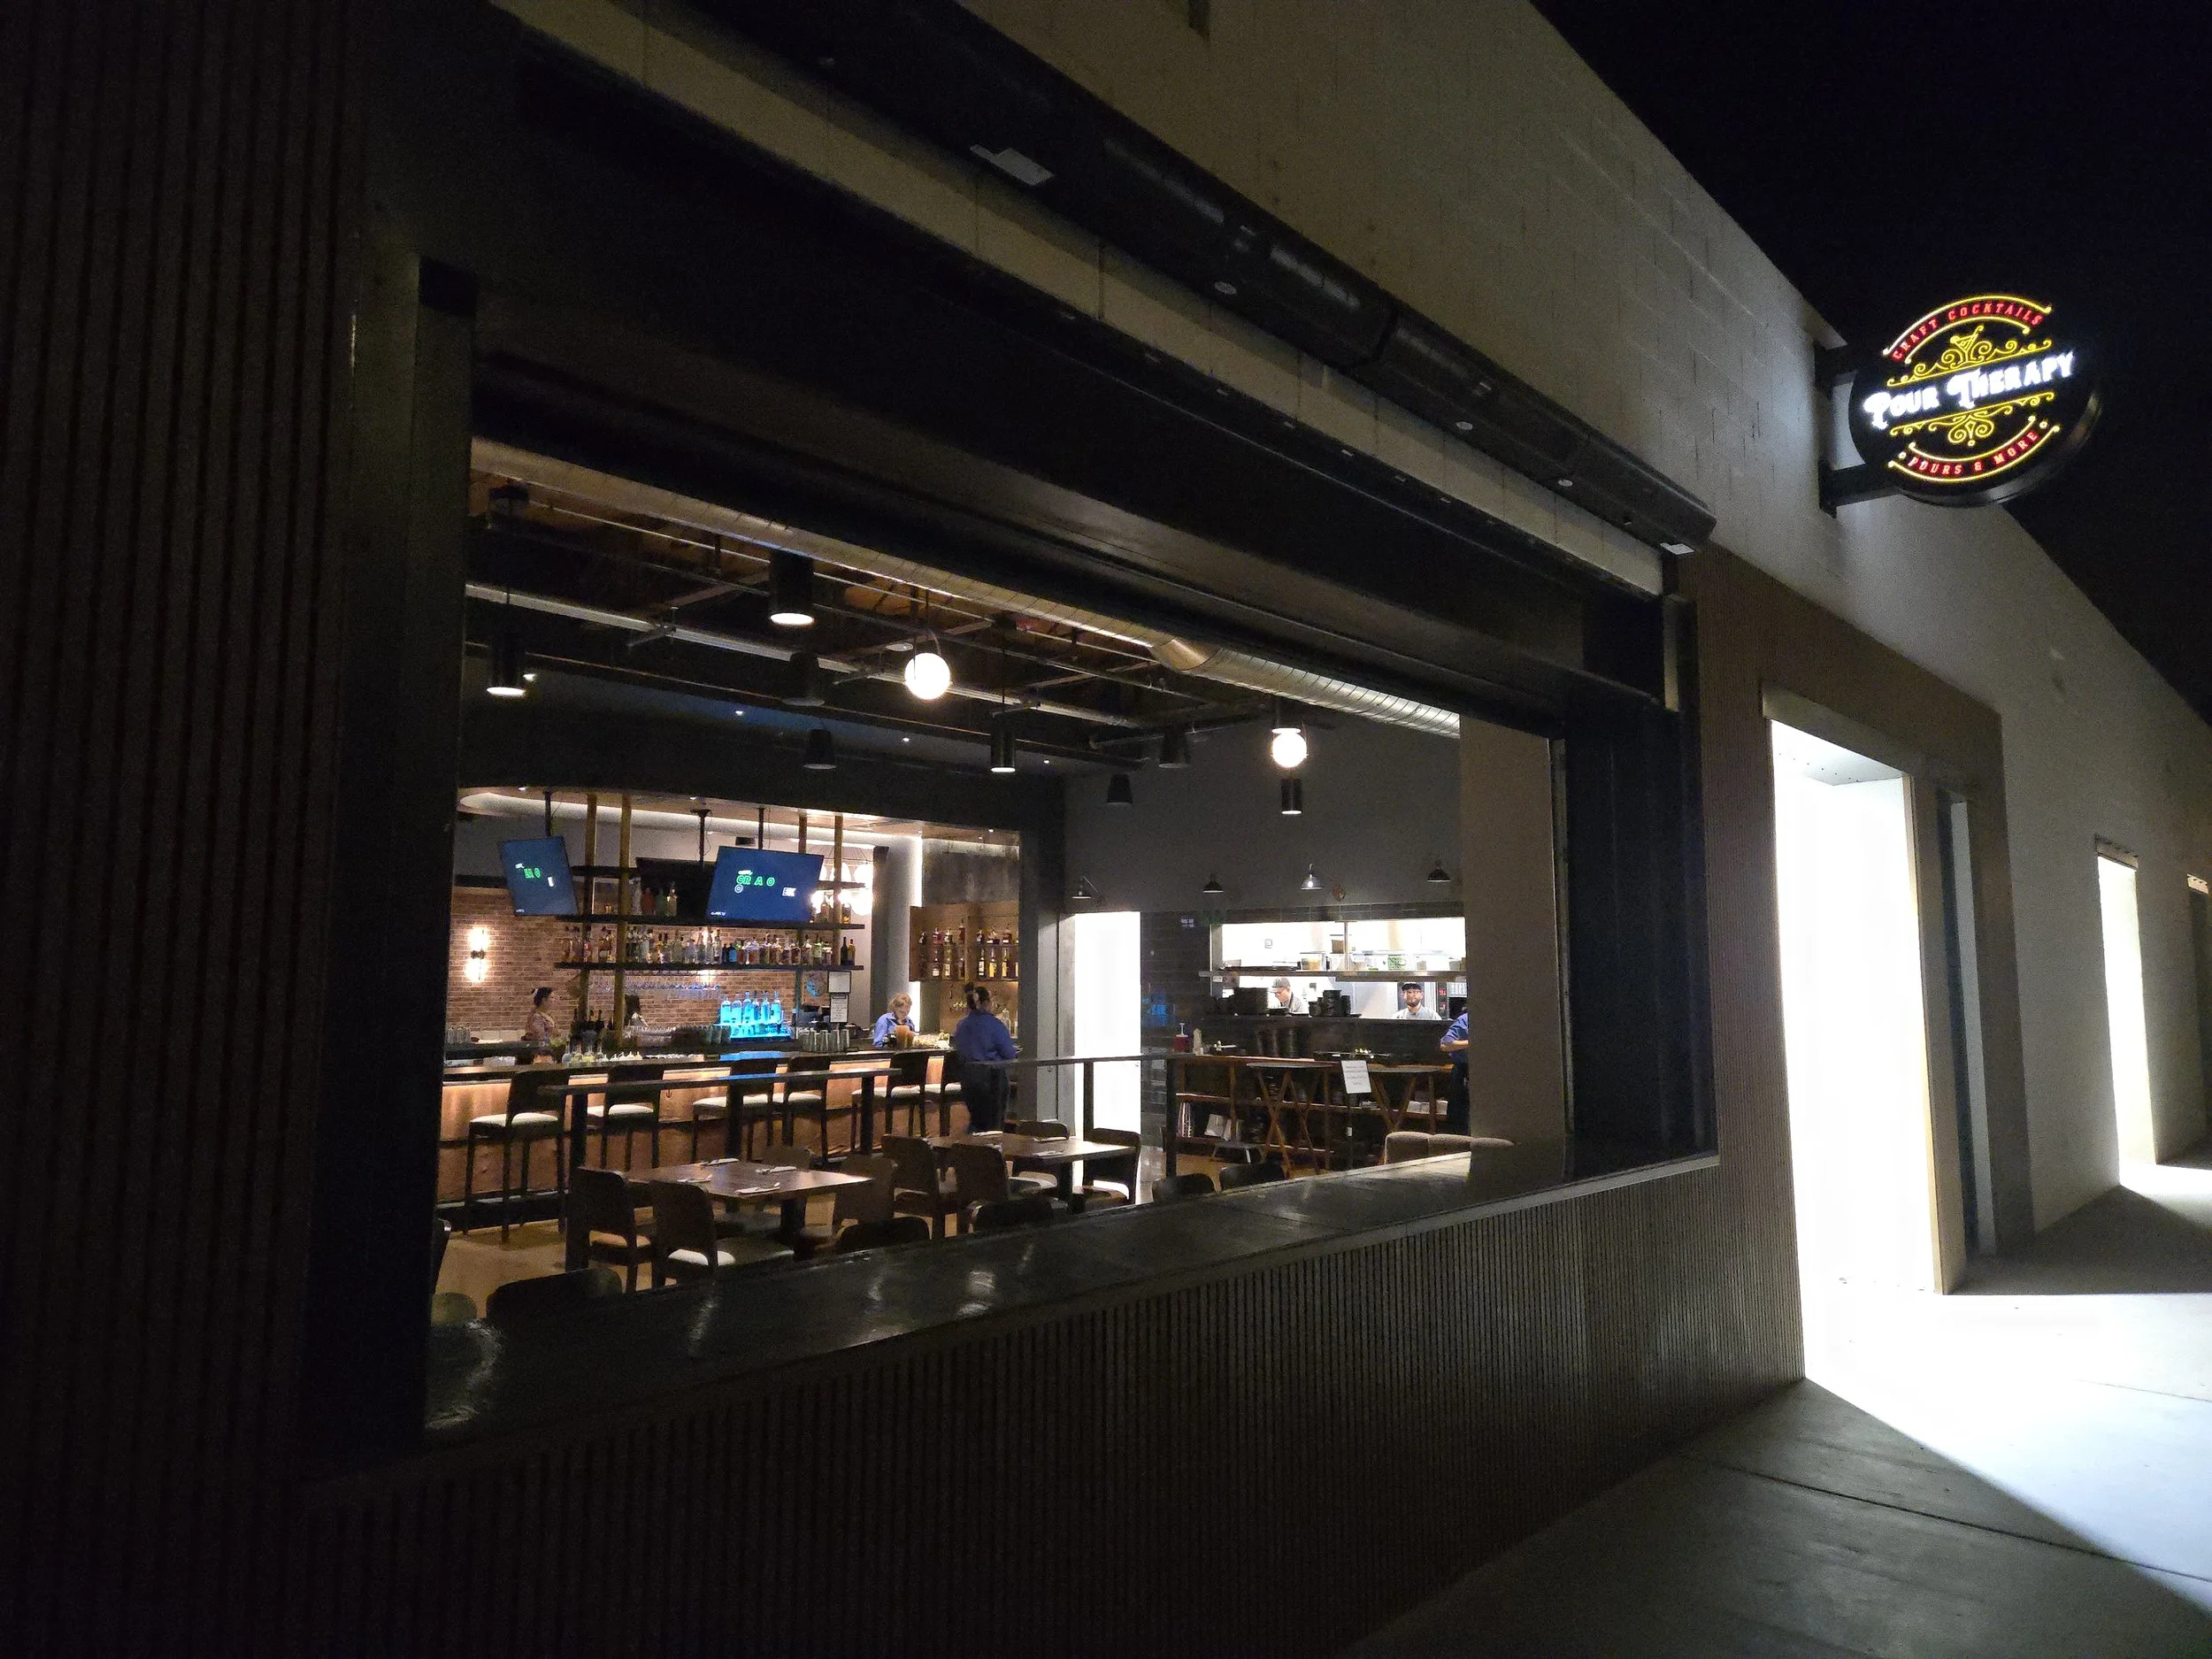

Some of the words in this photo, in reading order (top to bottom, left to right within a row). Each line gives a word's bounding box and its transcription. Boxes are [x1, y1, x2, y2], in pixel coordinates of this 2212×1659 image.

[1892, 319, 1939, 360] CRAFT
[1948, 302, 2044, 326] COCKTAILS
[1907, 456, 1962, 475] POURS
[1974, 461, 1984, 472] &
[1993, 431, 2039, 464] MORE
